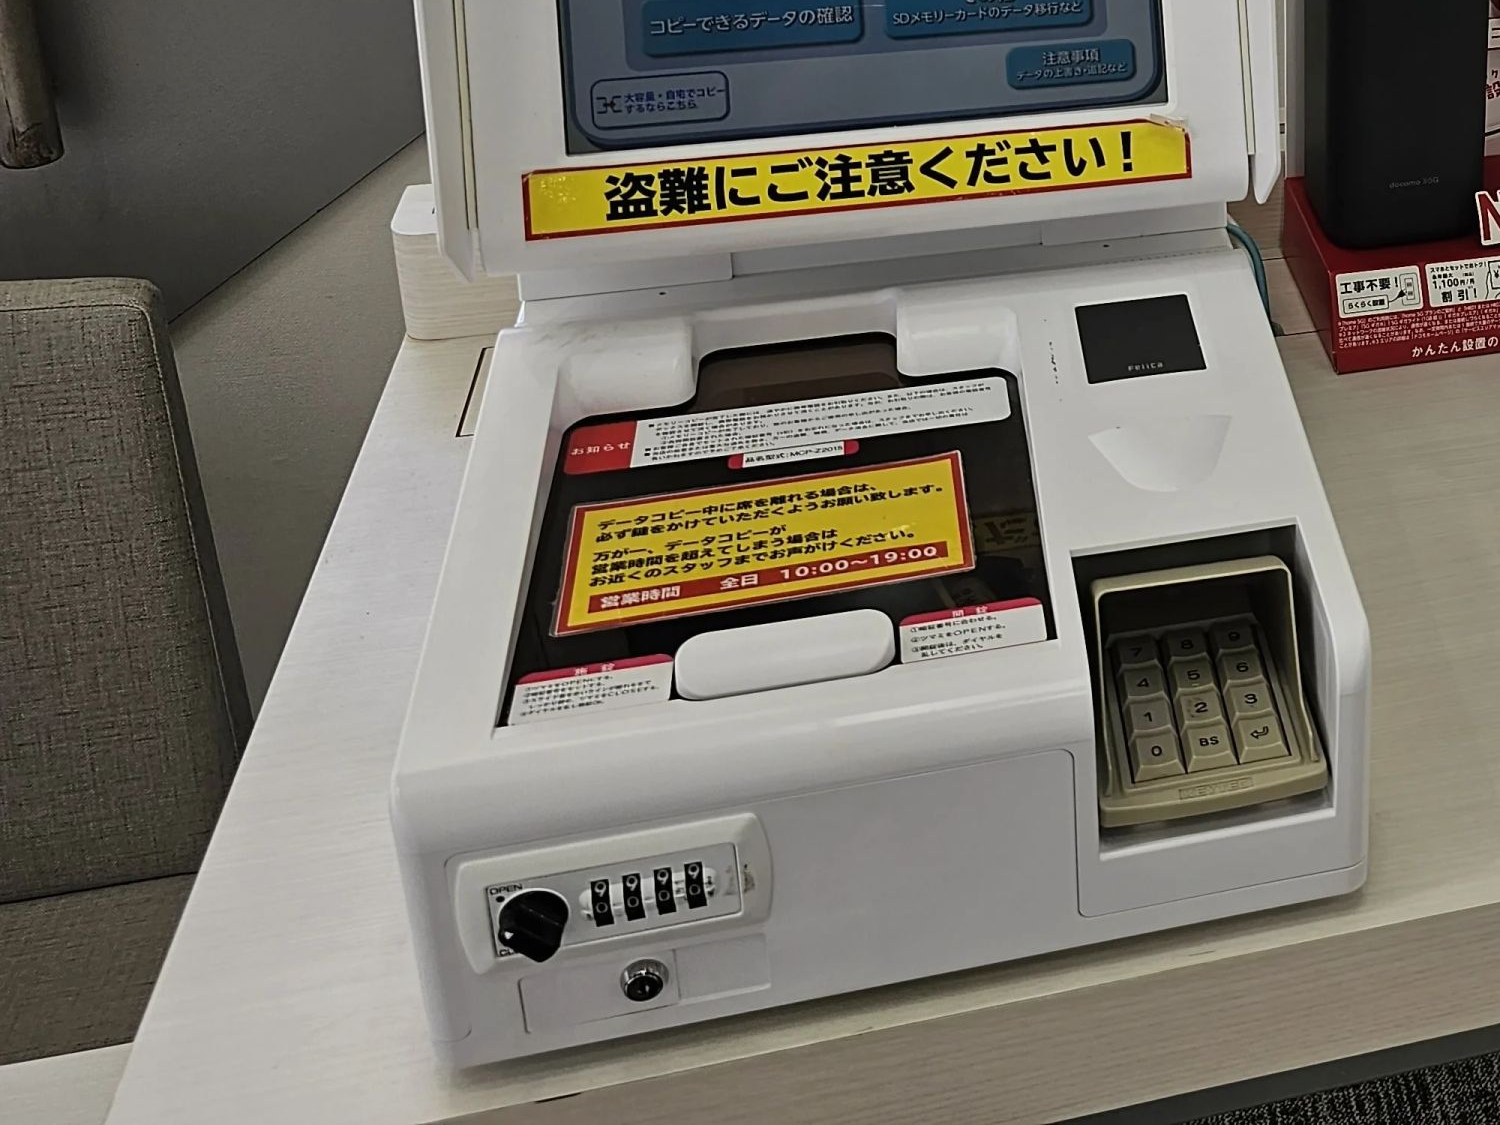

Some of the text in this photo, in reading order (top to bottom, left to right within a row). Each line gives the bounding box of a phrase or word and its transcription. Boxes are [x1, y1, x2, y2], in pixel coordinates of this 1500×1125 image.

[649, 5, 854, 35] コピーできるデータの確認
[604, 130, 1136, 222] 盗難にご注意ください！
[1411, 336, 1499, 358] かんたん設置の
[570, 439, 632, 457] お知らせ
[597, 483, 878, 530] データコピー中に席を離れる場合は、
[588, 530, 916, 587] お近くのスタッフまでお声がけください。
[591, 528, 839, 575] 営業時間を超えてしまう場合は
[592, 524, 788, 563] 万が一、データコピーが
[599, 586, 682, 610] 営業時間
[719, 573, 760, 591] 全日
[1132, 631, 1241, 657] 7 8 9
[1137, 661, 1249, 689] 4 5 6
[1144, 692, 1258, 723] 1 2 3
[1198, 734, 1220, 748] BS
[489, 883, 523, 896] OPEN
